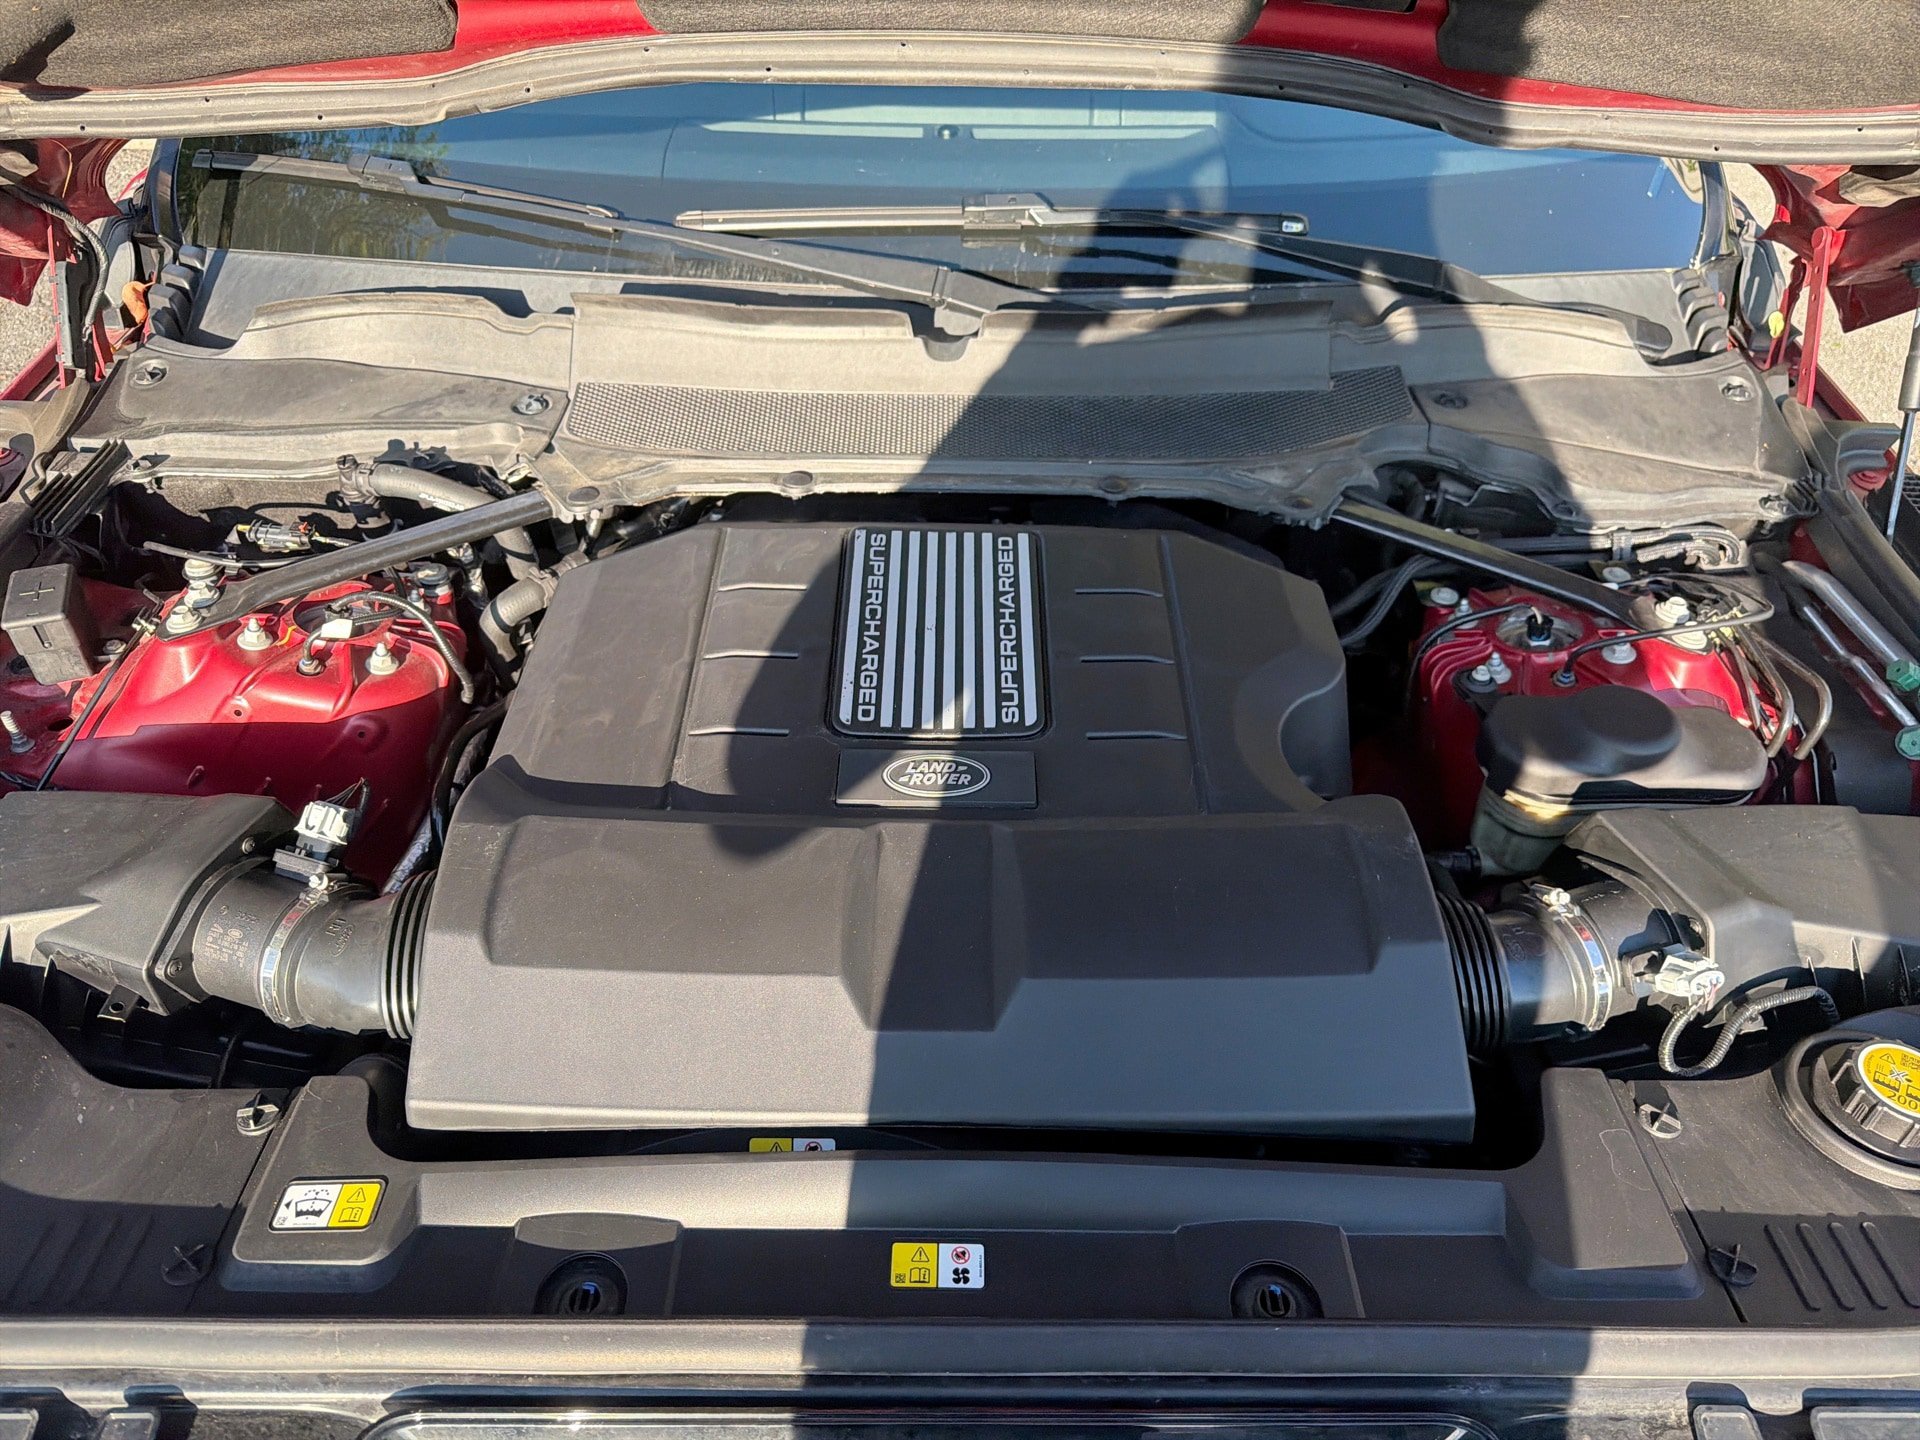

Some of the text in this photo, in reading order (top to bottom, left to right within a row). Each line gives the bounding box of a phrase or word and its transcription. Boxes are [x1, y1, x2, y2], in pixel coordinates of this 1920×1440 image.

[857, 533, 886, 722] SUPERCHARGED
[998, 536, 1019, 724] SUPERCHARGED
[906, 761, 956, 773] LAND
[909, 773, 971, 785] ROVER
